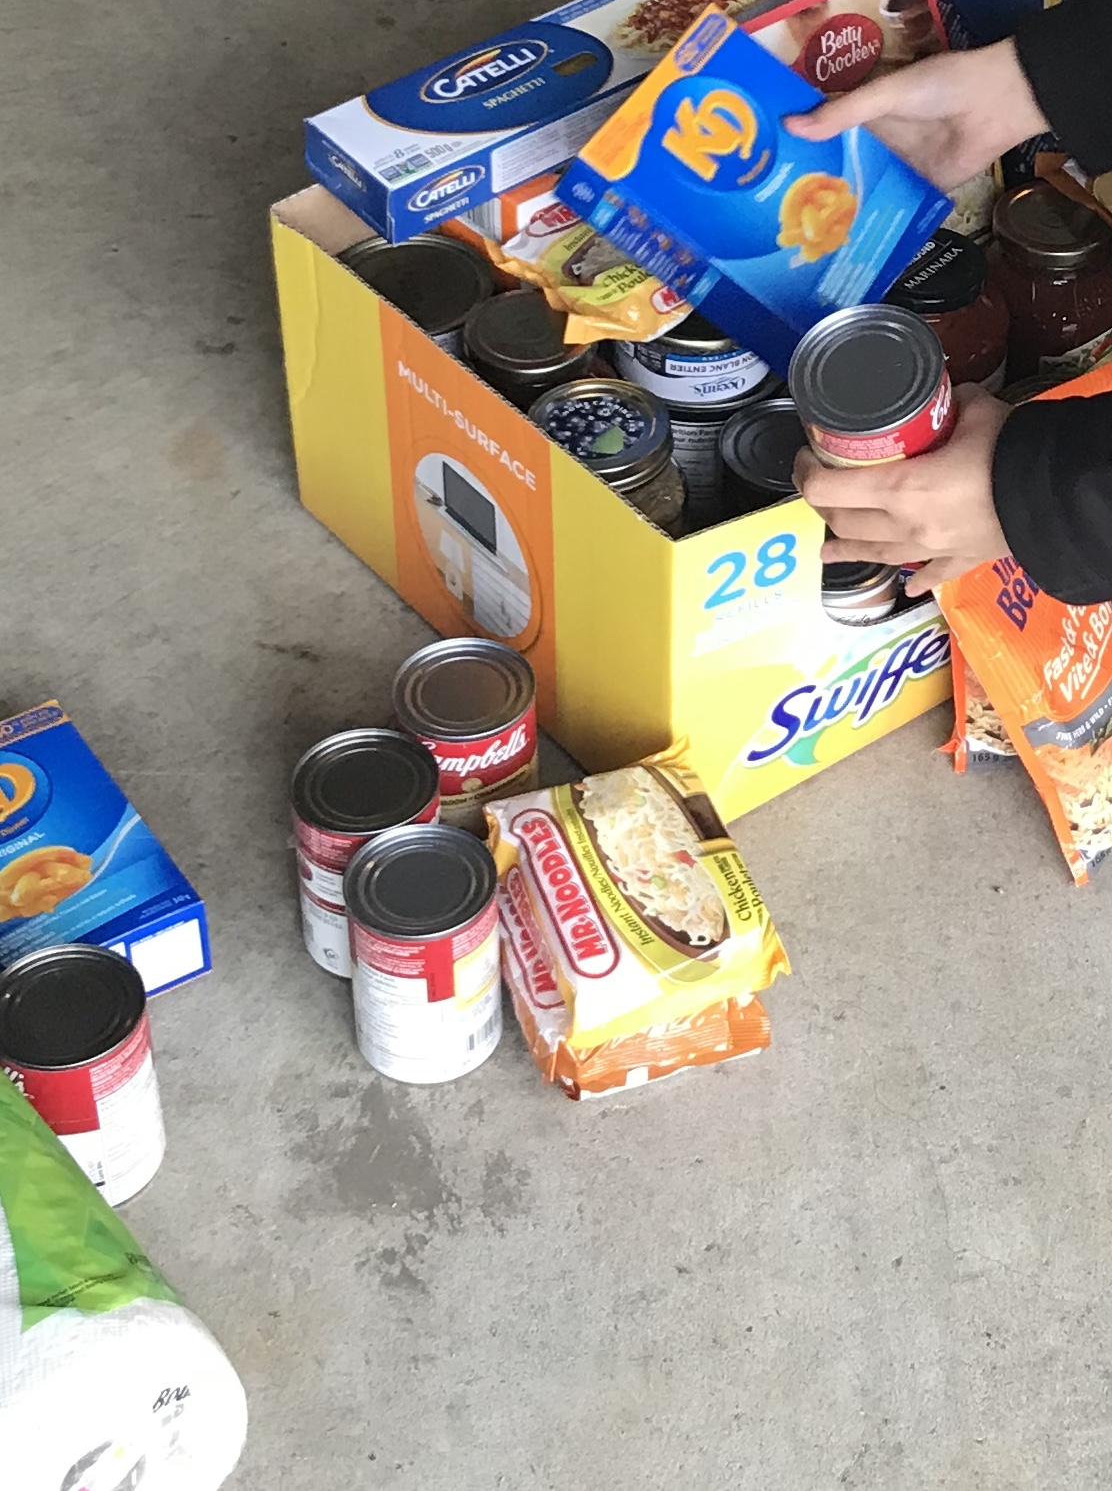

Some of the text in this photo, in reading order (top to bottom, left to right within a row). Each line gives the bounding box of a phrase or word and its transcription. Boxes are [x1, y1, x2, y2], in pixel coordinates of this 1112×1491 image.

[816, 41, 876, 82] Crocker
[821, 25, 863, 57] Betty
[433, 47, 538, 98] CATELLI
[482, 76, 547, 110] SPAGHETTI
[661, 88, 758, 182] KD
[416, 171, 476, 208] CATELLI
[903, 247, 964, 290] MARINARA
[669, 363, 708, 373] ENTIER
[708, 359, 740, 373] BLANC
[397, 360, 537, 492] MULTI-SURFACE
[703, 533, 797, 610] 28
[1043, 635, 1075, 691] Fast
[1059, 654, 1093, 703] Vite
[1055, 730, 1073, 742] FINE
[520, 816, 591, 925] NOODLES
[724, 870, 753, 922] Chicken
[619, 912, 656, 946] Instant
